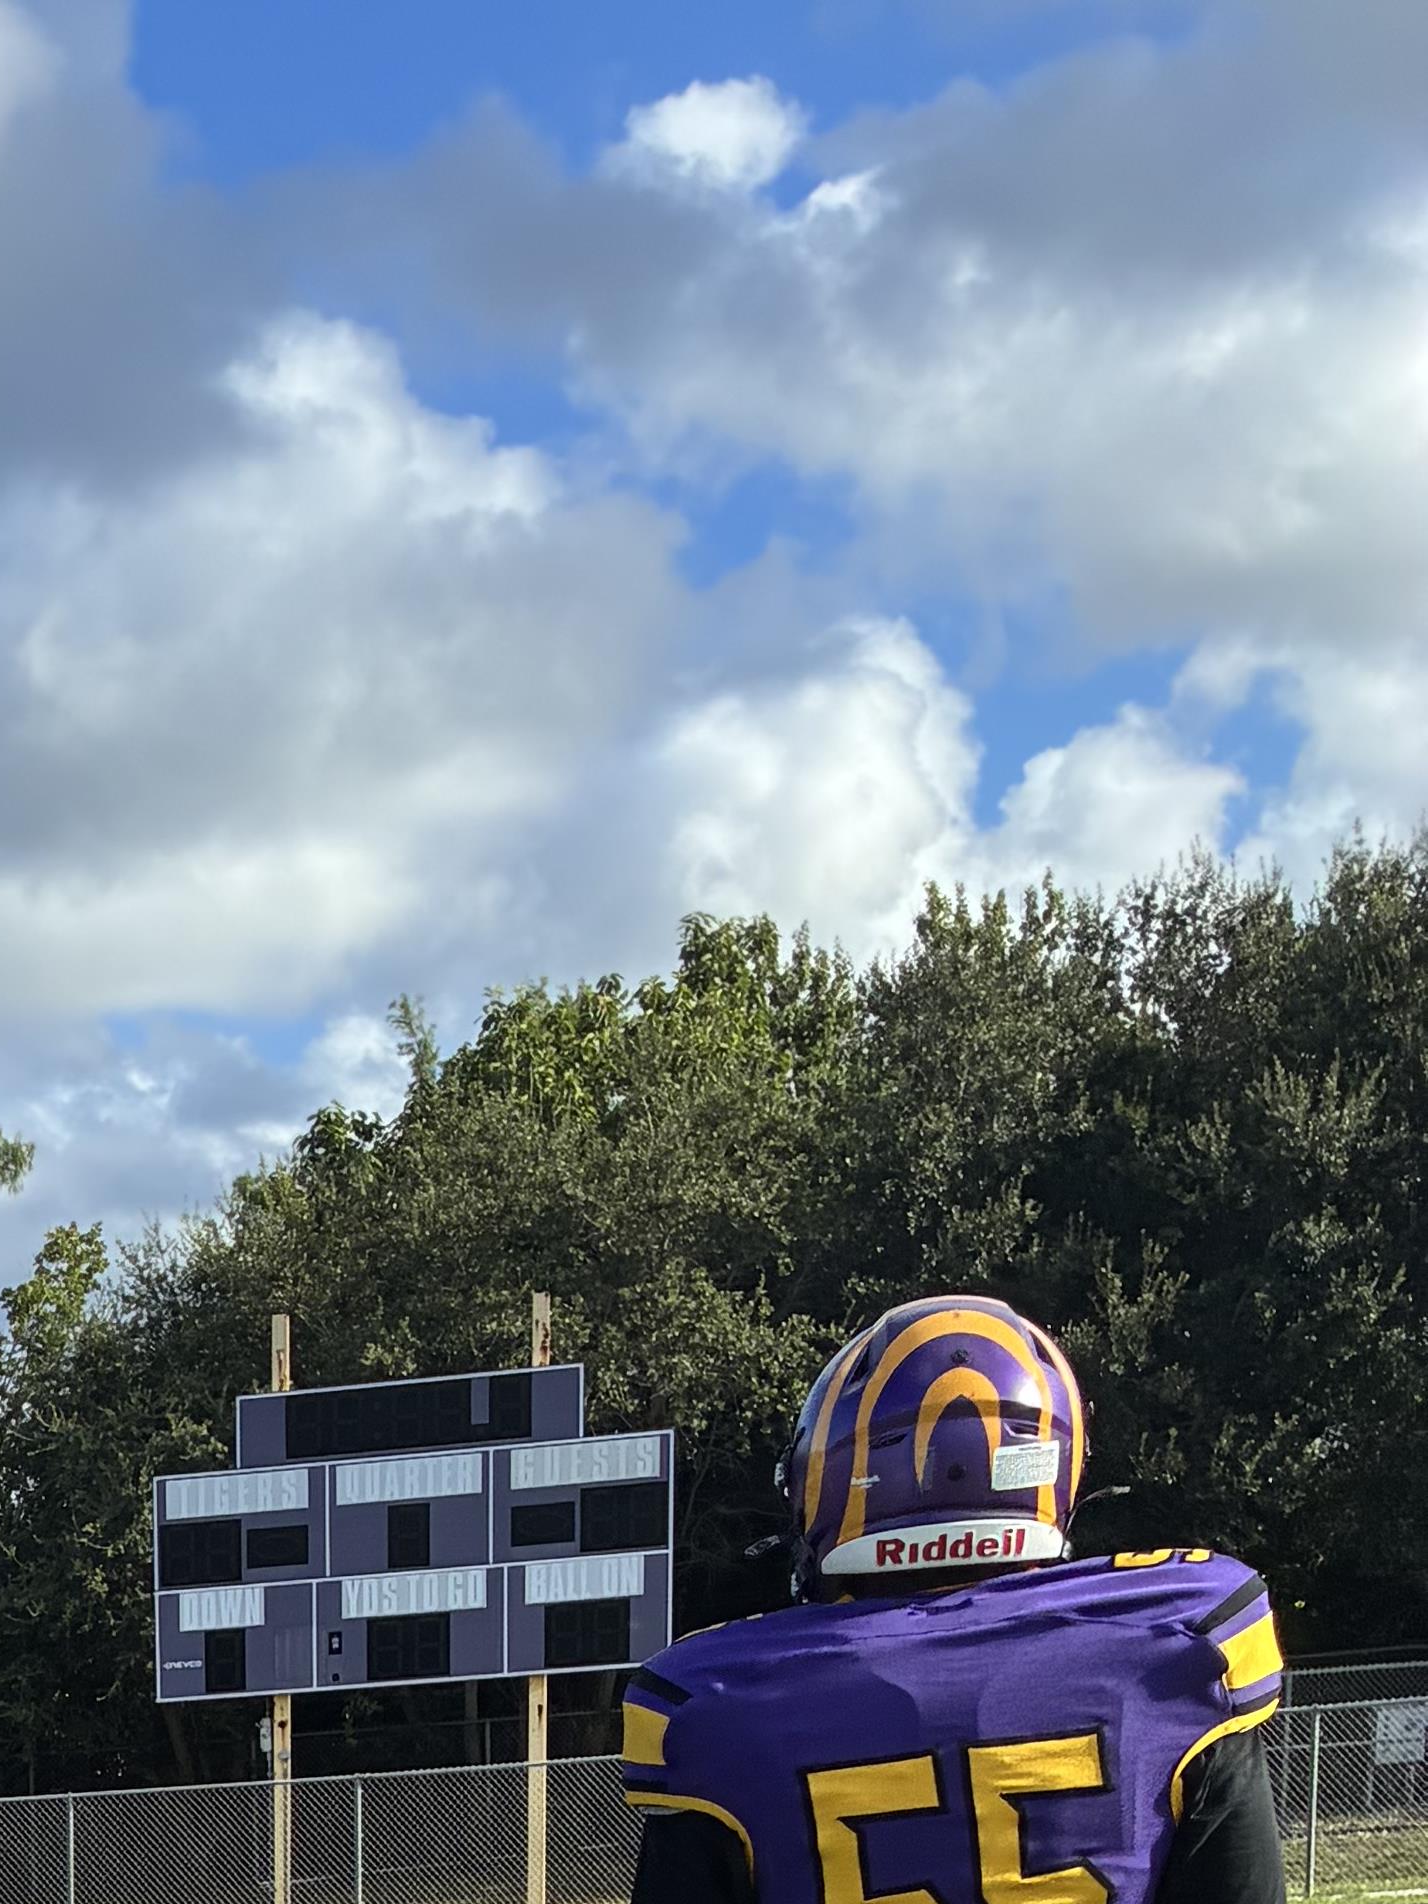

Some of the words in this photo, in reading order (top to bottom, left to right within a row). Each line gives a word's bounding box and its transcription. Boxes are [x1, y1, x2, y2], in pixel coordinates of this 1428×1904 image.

[345, 1454, 474, 1501] QUARTER
[518, 1438, 655, 1488] GUESTS
[179, 1471, 297, 1519] TIGERS
[876, 1528, 1026, 1567] Riddell
[406, 1573, 440, 1611] TO
[447, 1570, 481, 1608] GO
[532, 1562, 591, 1603] BALL
[602, 1556, 639, 1597] ON
[187, 1587, 262, 1630] DOWN
